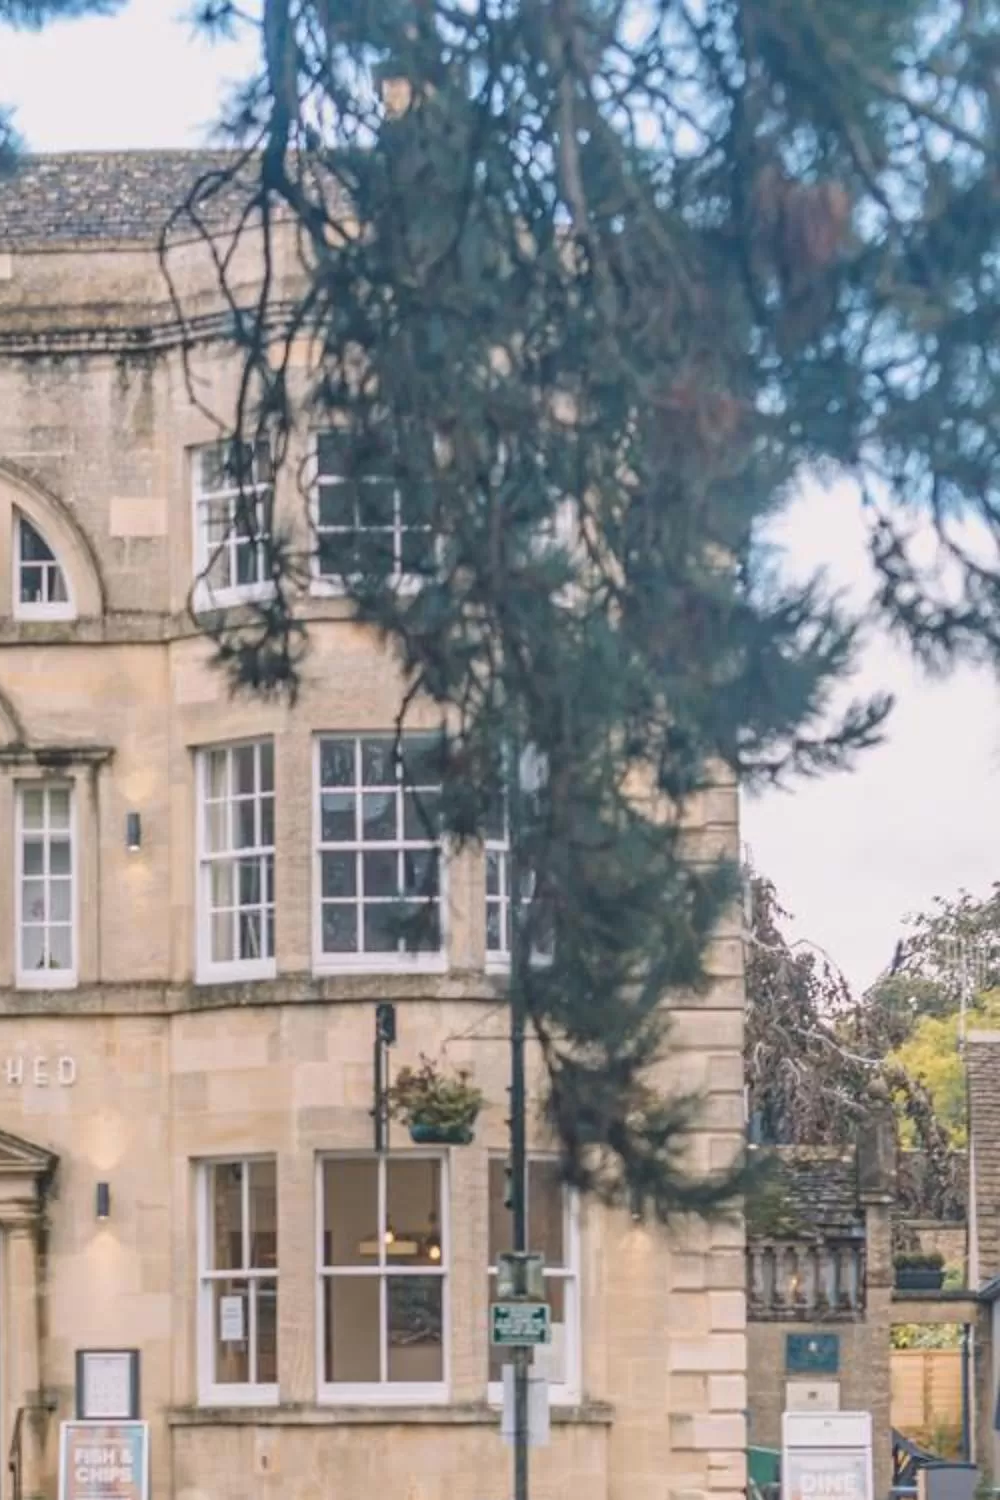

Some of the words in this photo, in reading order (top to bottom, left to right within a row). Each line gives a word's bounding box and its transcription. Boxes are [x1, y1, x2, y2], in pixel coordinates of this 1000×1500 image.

[74, 1447, 115, 1465] FISH
[74, 1466, 133, 1483] CHIPS
[799, 1472, 857, 1493] DINE
